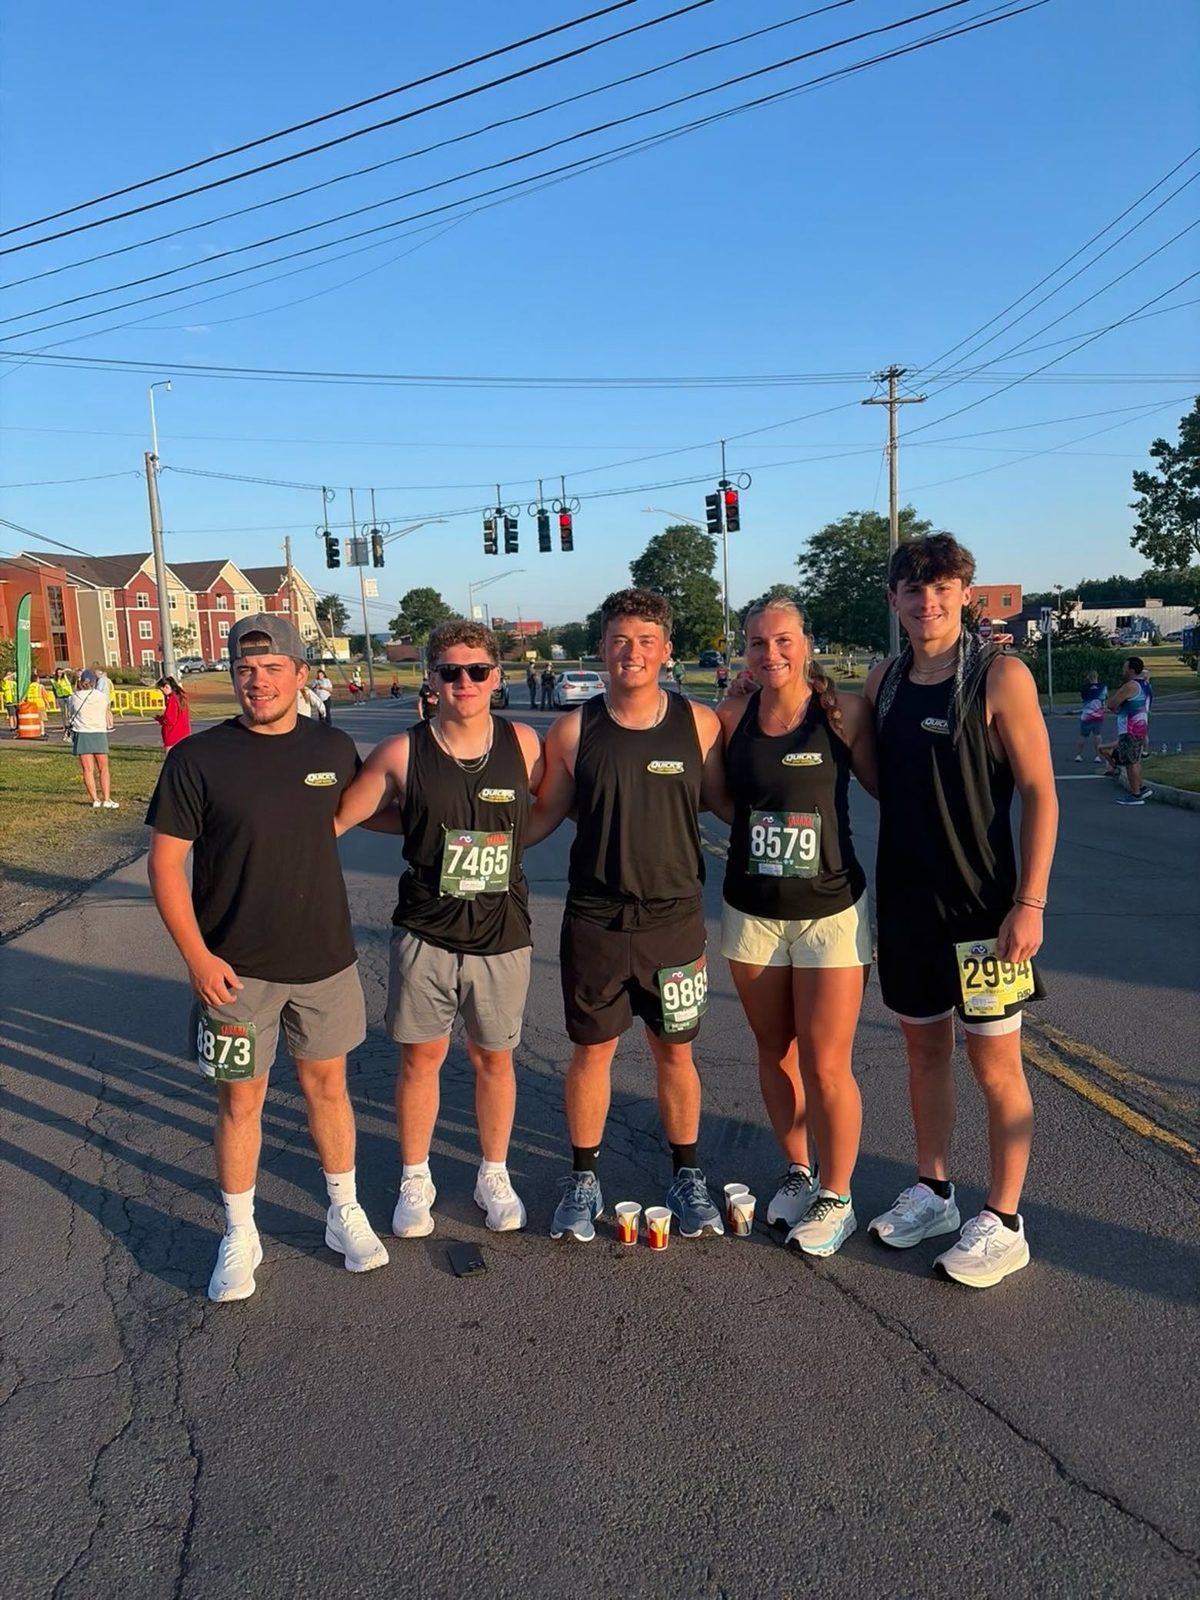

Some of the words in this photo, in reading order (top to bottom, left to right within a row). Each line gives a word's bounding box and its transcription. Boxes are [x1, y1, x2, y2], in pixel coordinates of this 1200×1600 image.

[751, 825, 816, 861] 8579
[447, 844, 509, 876] 7465
[963, 956, 1030, 989] 2994
